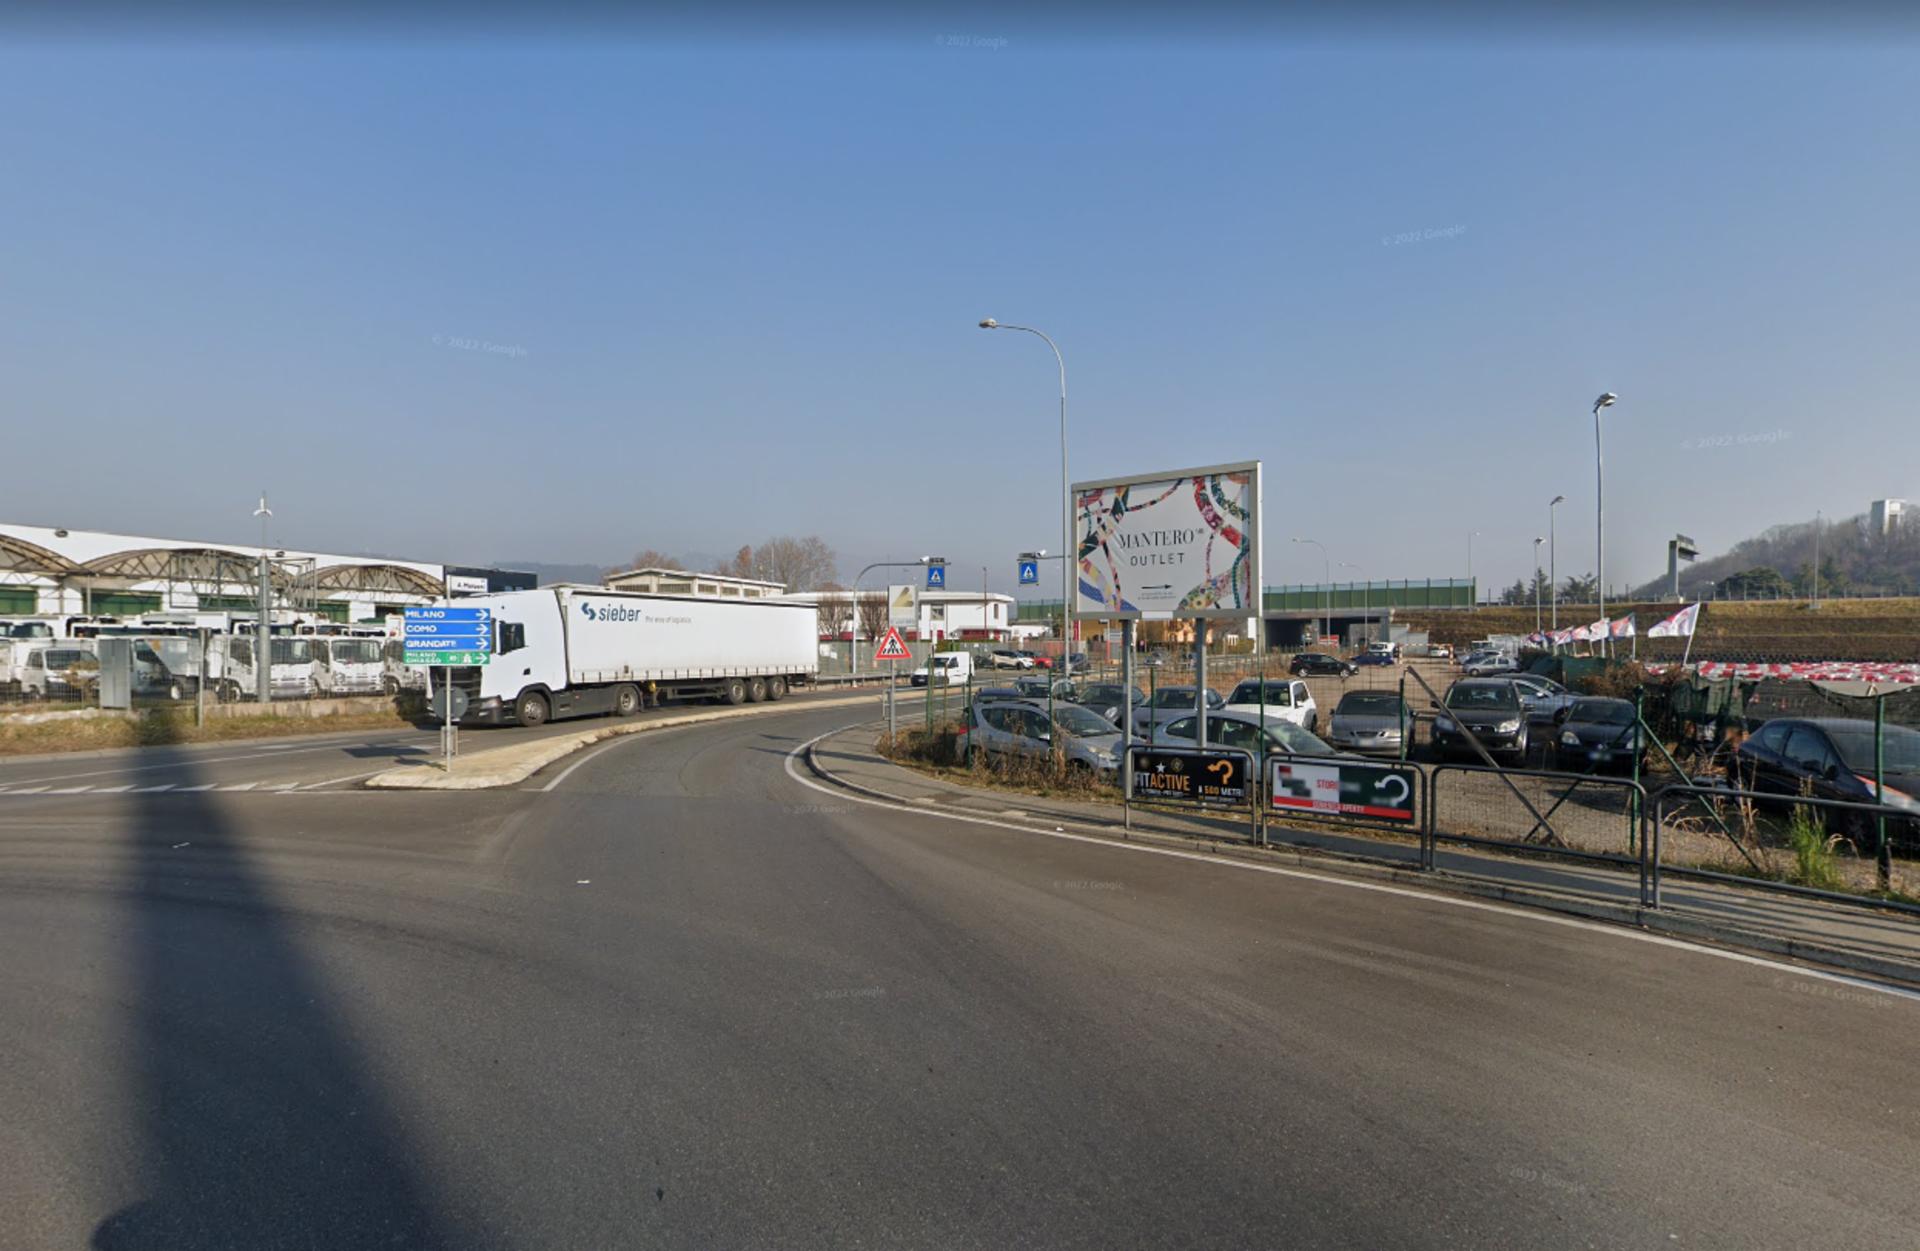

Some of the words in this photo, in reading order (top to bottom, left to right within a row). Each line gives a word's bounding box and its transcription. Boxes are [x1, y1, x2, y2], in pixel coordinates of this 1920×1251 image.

[1119, 529, 1195, 548] MANTERO
[1130, 552, 1185, 567] OUTLET
[405, 610, 445, 618] MILANO
[599, 603, 641, 622] sieber
[406, 625, 437, 633] COMO
[406, 640, 457, 648] GRANDATE
[1134, 771, 1190, 791] FITACTIVE
